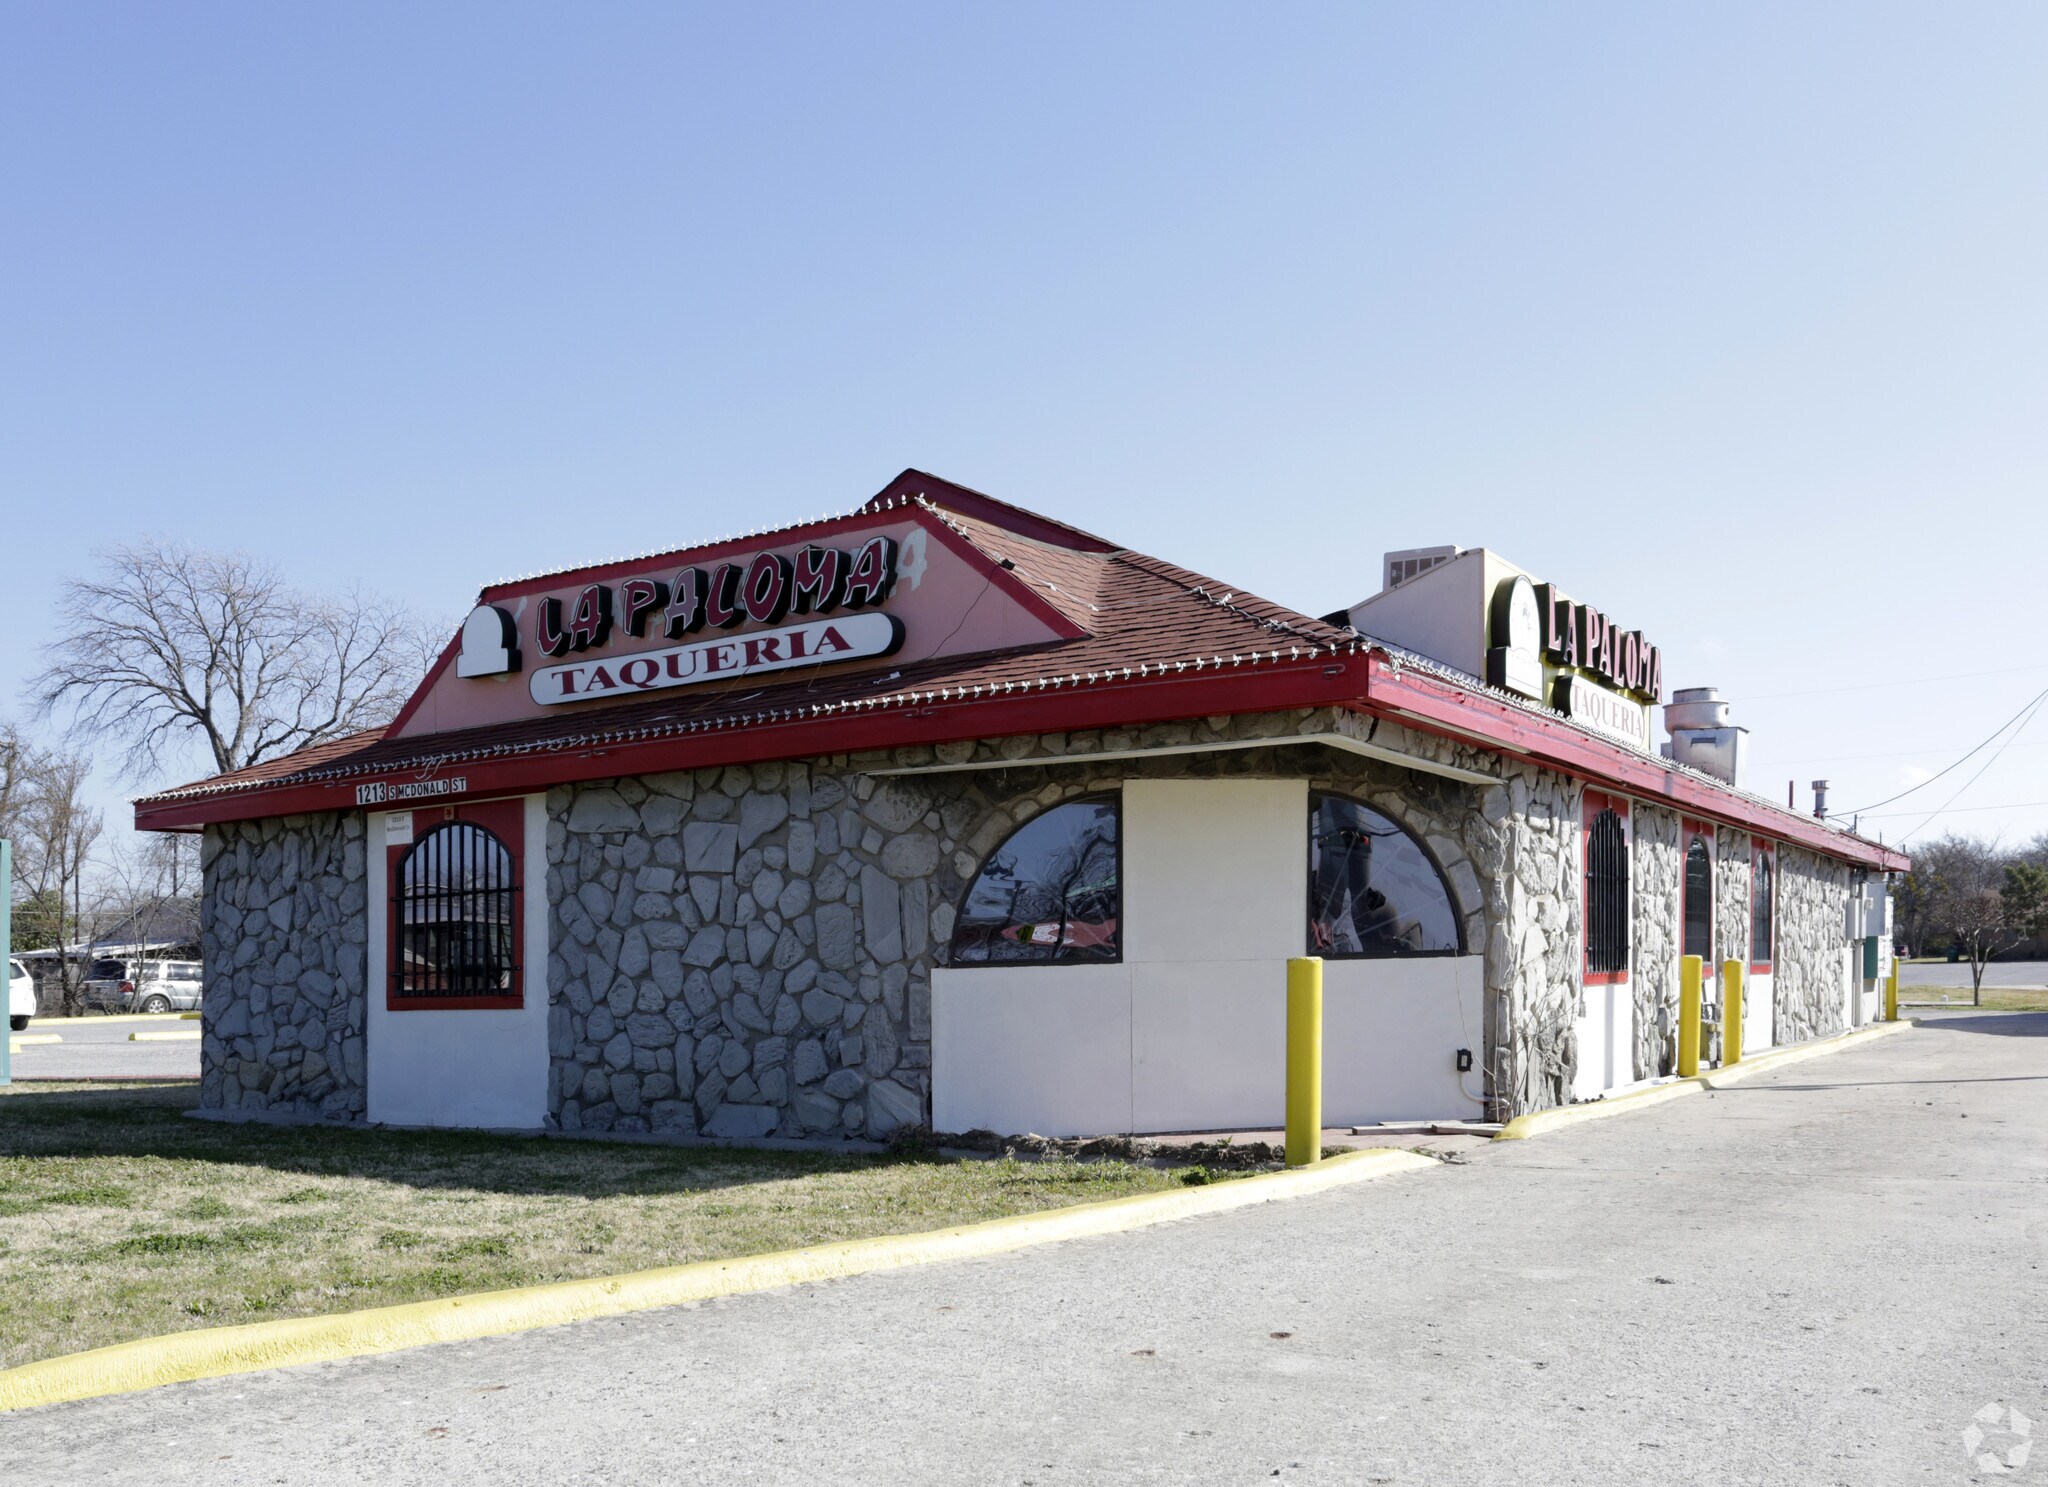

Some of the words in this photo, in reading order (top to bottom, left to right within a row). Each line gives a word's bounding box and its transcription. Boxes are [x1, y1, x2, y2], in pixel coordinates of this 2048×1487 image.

[536, 584, 602, 656] LA
[622, 535, 894, 637] PALOMA
[551, 626, 853, 696] TAQUERIA
[1548, 582, 1578, 668] LA
[1585, 604, 1662, 704] PALOMA
[1572, 684, 1643, 739] TAQUERIA
[357, 782, 386, 803] 1213
[389, 786, 395, 799] S
[398, 780, 449, 798] MCDONALD
[452, 778, 466, 791] ST
